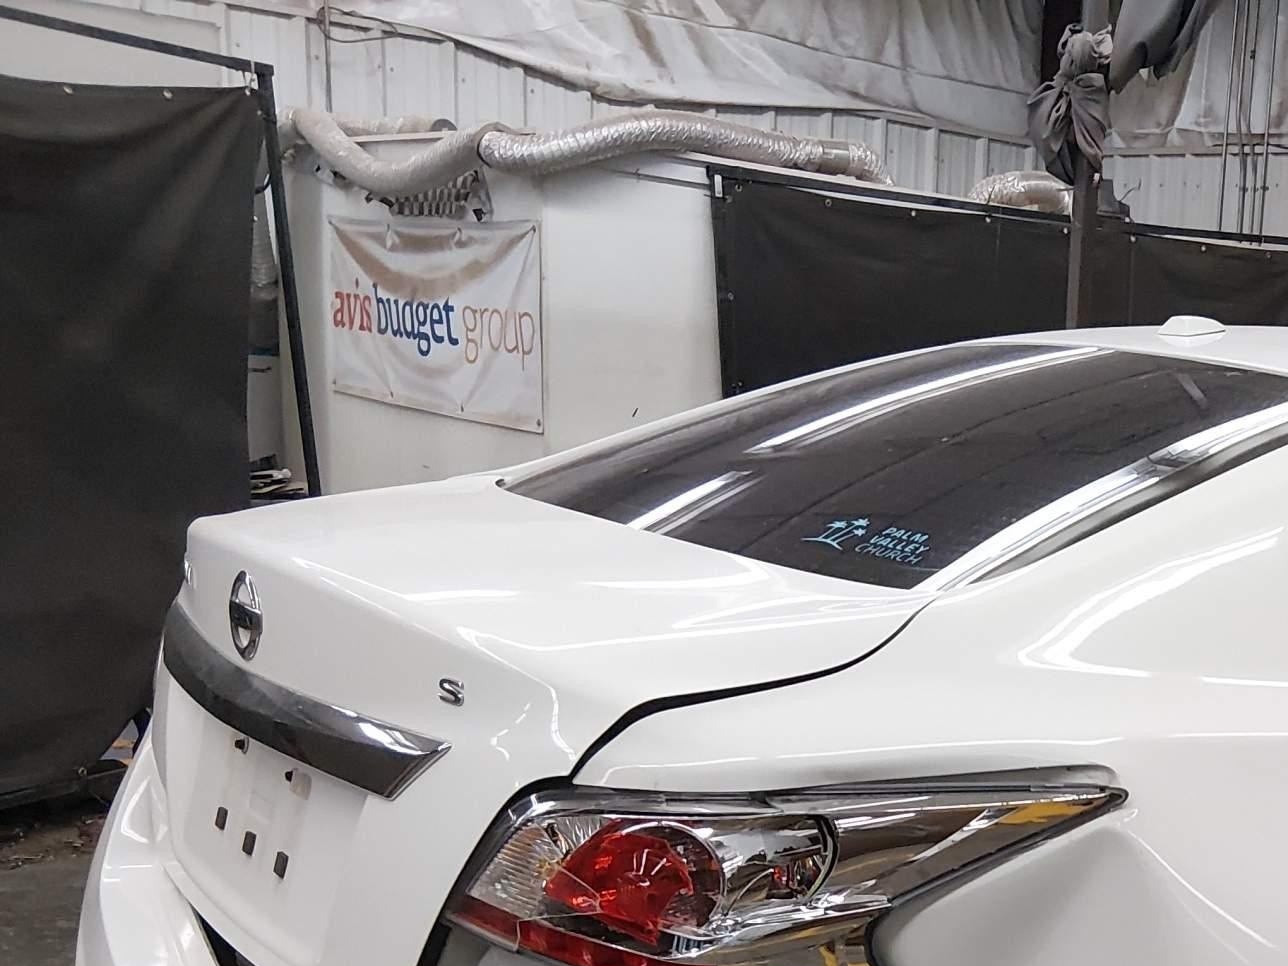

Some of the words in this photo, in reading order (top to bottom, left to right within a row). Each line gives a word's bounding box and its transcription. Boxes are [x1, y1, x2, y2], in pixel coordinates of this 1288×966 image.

[333, 278, 372, 333] avis
[373, 282, 459, 357] budget
[462, 305, 535, 371] group
[869, 535, 930, 554] VALLEY
[882, 526, 929, 544] PALM
[855, 543, 922, 564] CHURCH
[438, 678, 464, 707] S
